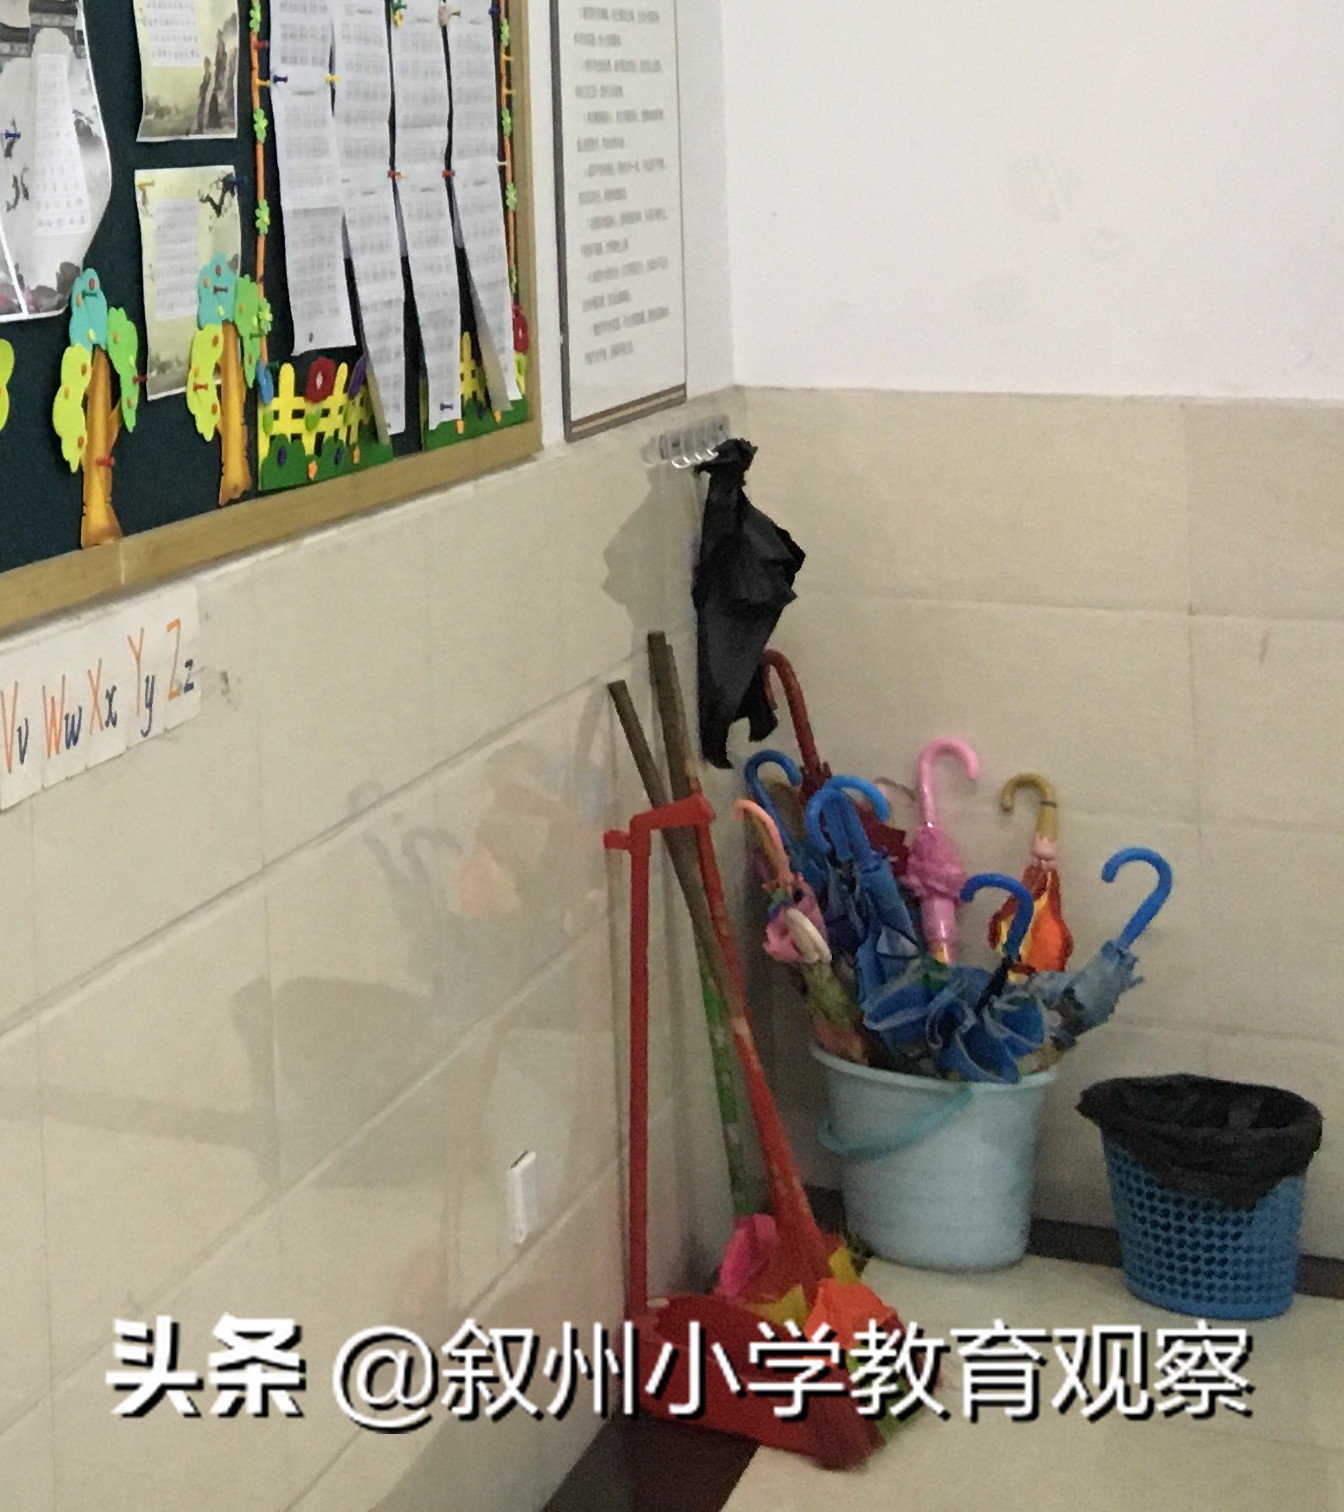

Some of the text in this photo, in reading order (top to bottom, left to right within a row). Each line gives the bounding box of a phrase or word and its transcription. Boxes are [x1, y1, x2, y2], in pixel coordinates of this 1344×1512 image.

[0, 680, 30, 774] Vv
[41, 673, 83, 759] Ww
[87, 658, 118, 736] Xx
[126, 627, 155, 738] Yy
[166, 618, 194, 701] Zz
